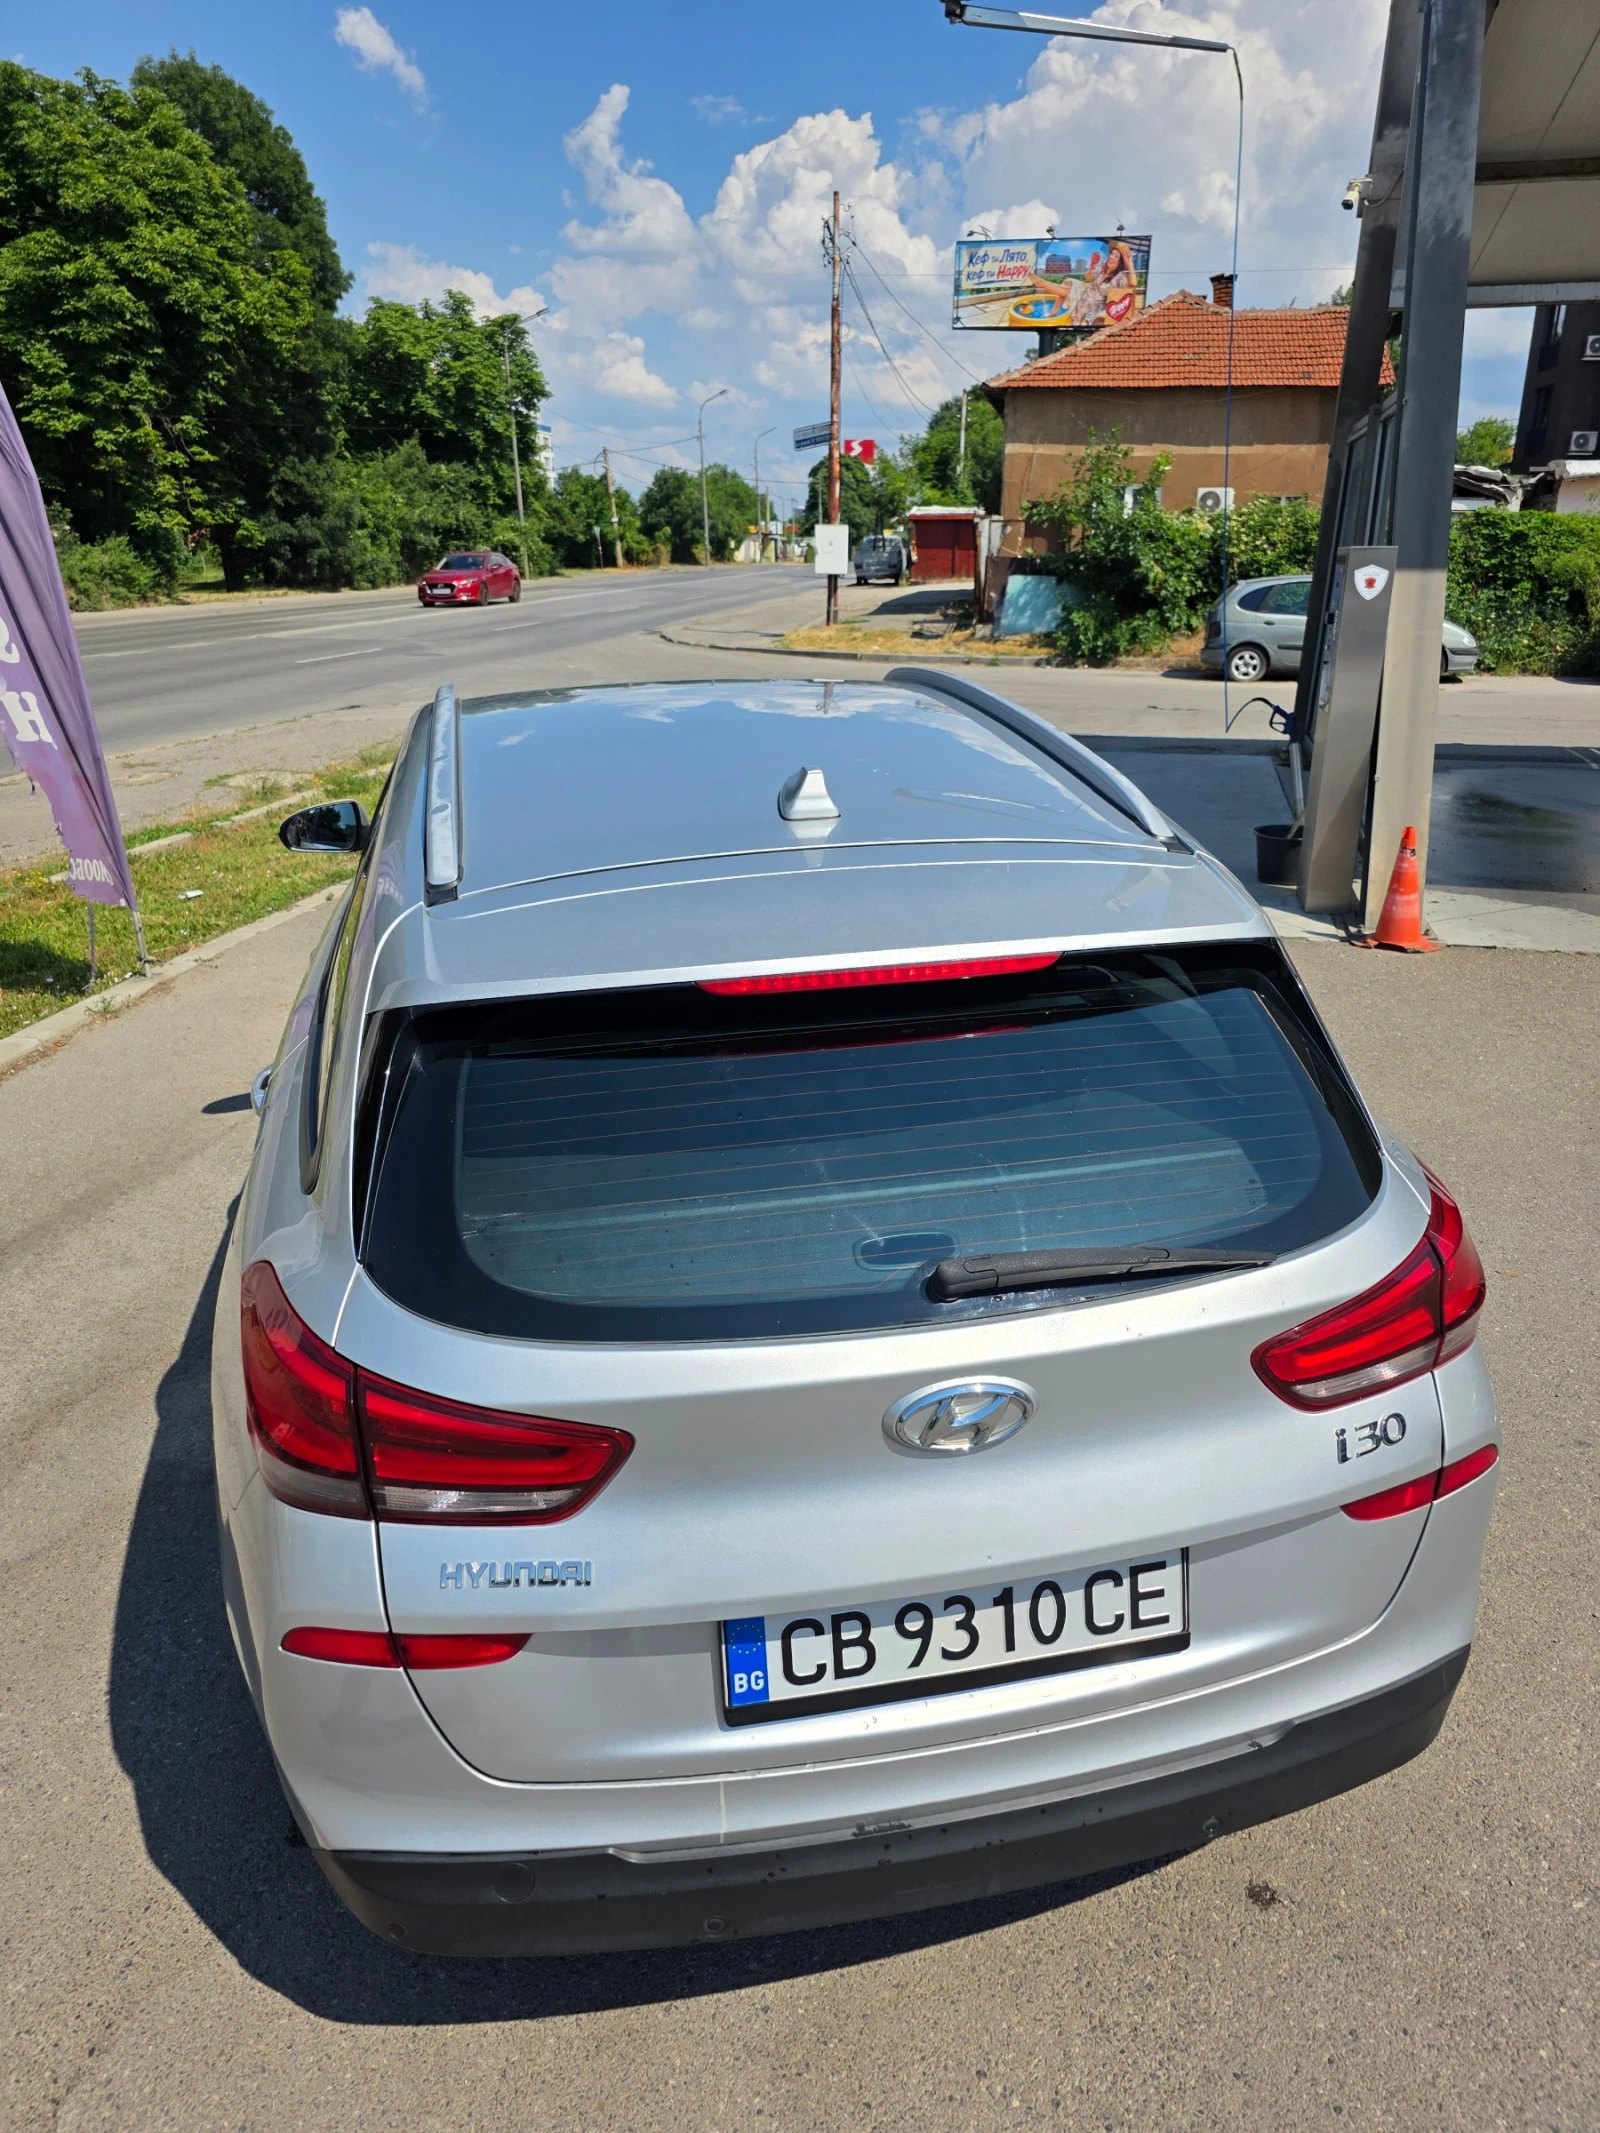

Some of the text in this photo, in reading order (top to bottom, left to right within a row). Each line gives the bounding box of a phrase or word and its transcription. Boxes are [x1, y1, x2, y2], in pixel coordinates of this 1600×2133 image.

[1335, 1412, 1407, 1464] i30
[440, 1560, 592, 1590] HYUNDAI
[780, 1560, 1170, 1686] CB 9310 CE
[733, 1670, 765, 1694] BG
